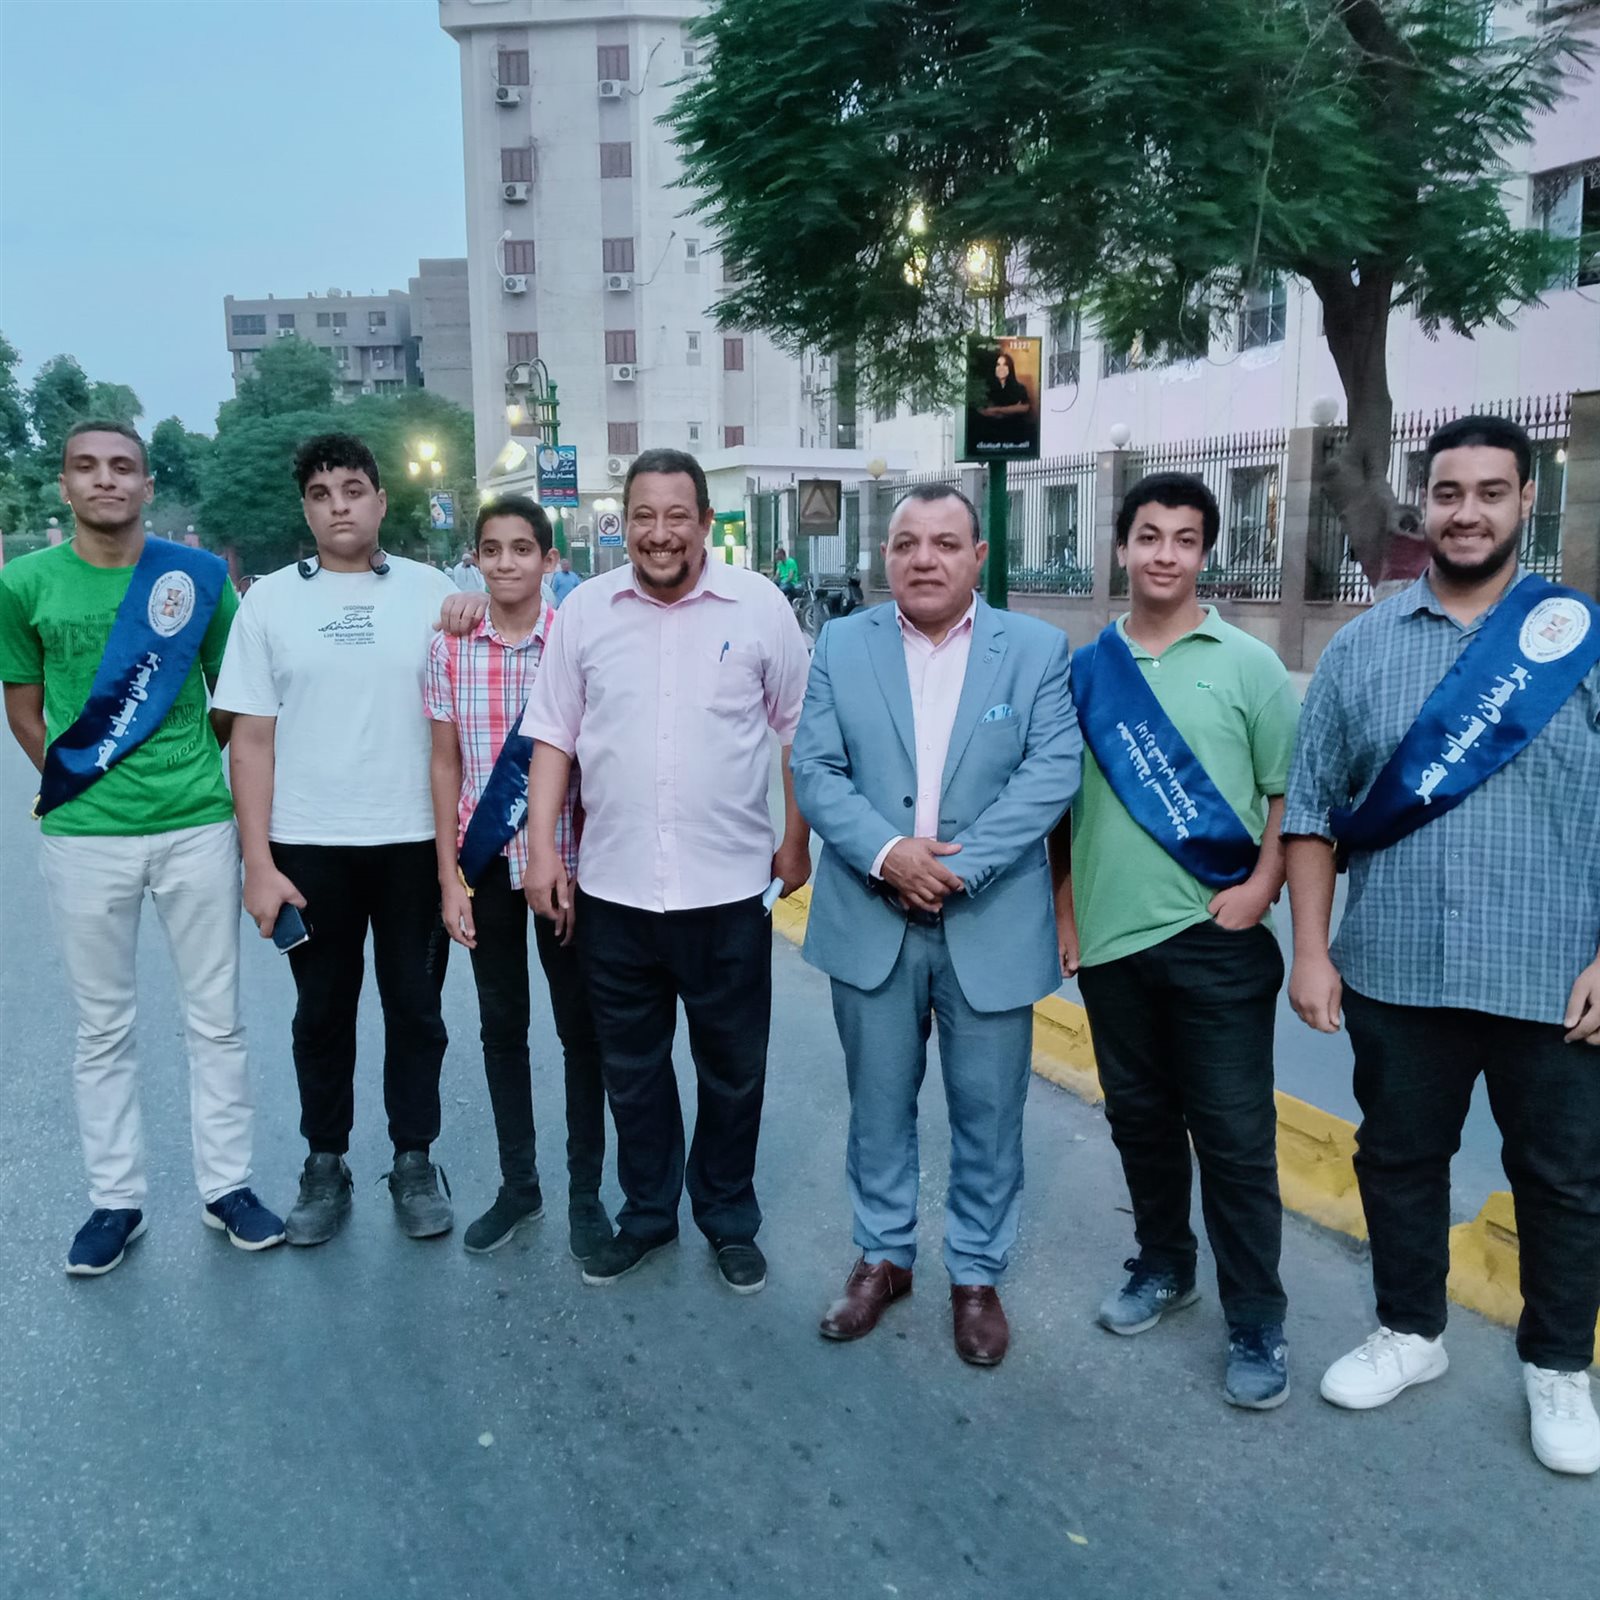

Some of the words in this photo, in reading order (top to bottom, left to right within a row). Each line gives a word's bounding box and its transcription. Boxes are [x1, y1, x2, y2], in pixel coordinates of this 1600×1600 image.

[129, 651, 162, 702] برلمان
[1478, 663, 1533, 725] برلمان
[109, 696, 139, 737] شباب
[94, 739, 118, 771] مصر
[1116, 722, 1151, 781] محافظة
[1440, 714, 1487, 764] شباب
[1147, 747, 1176, 780] شباب
[1415, 762, 1449, 805] مصر
[506, 798, 528, 831] مصر
